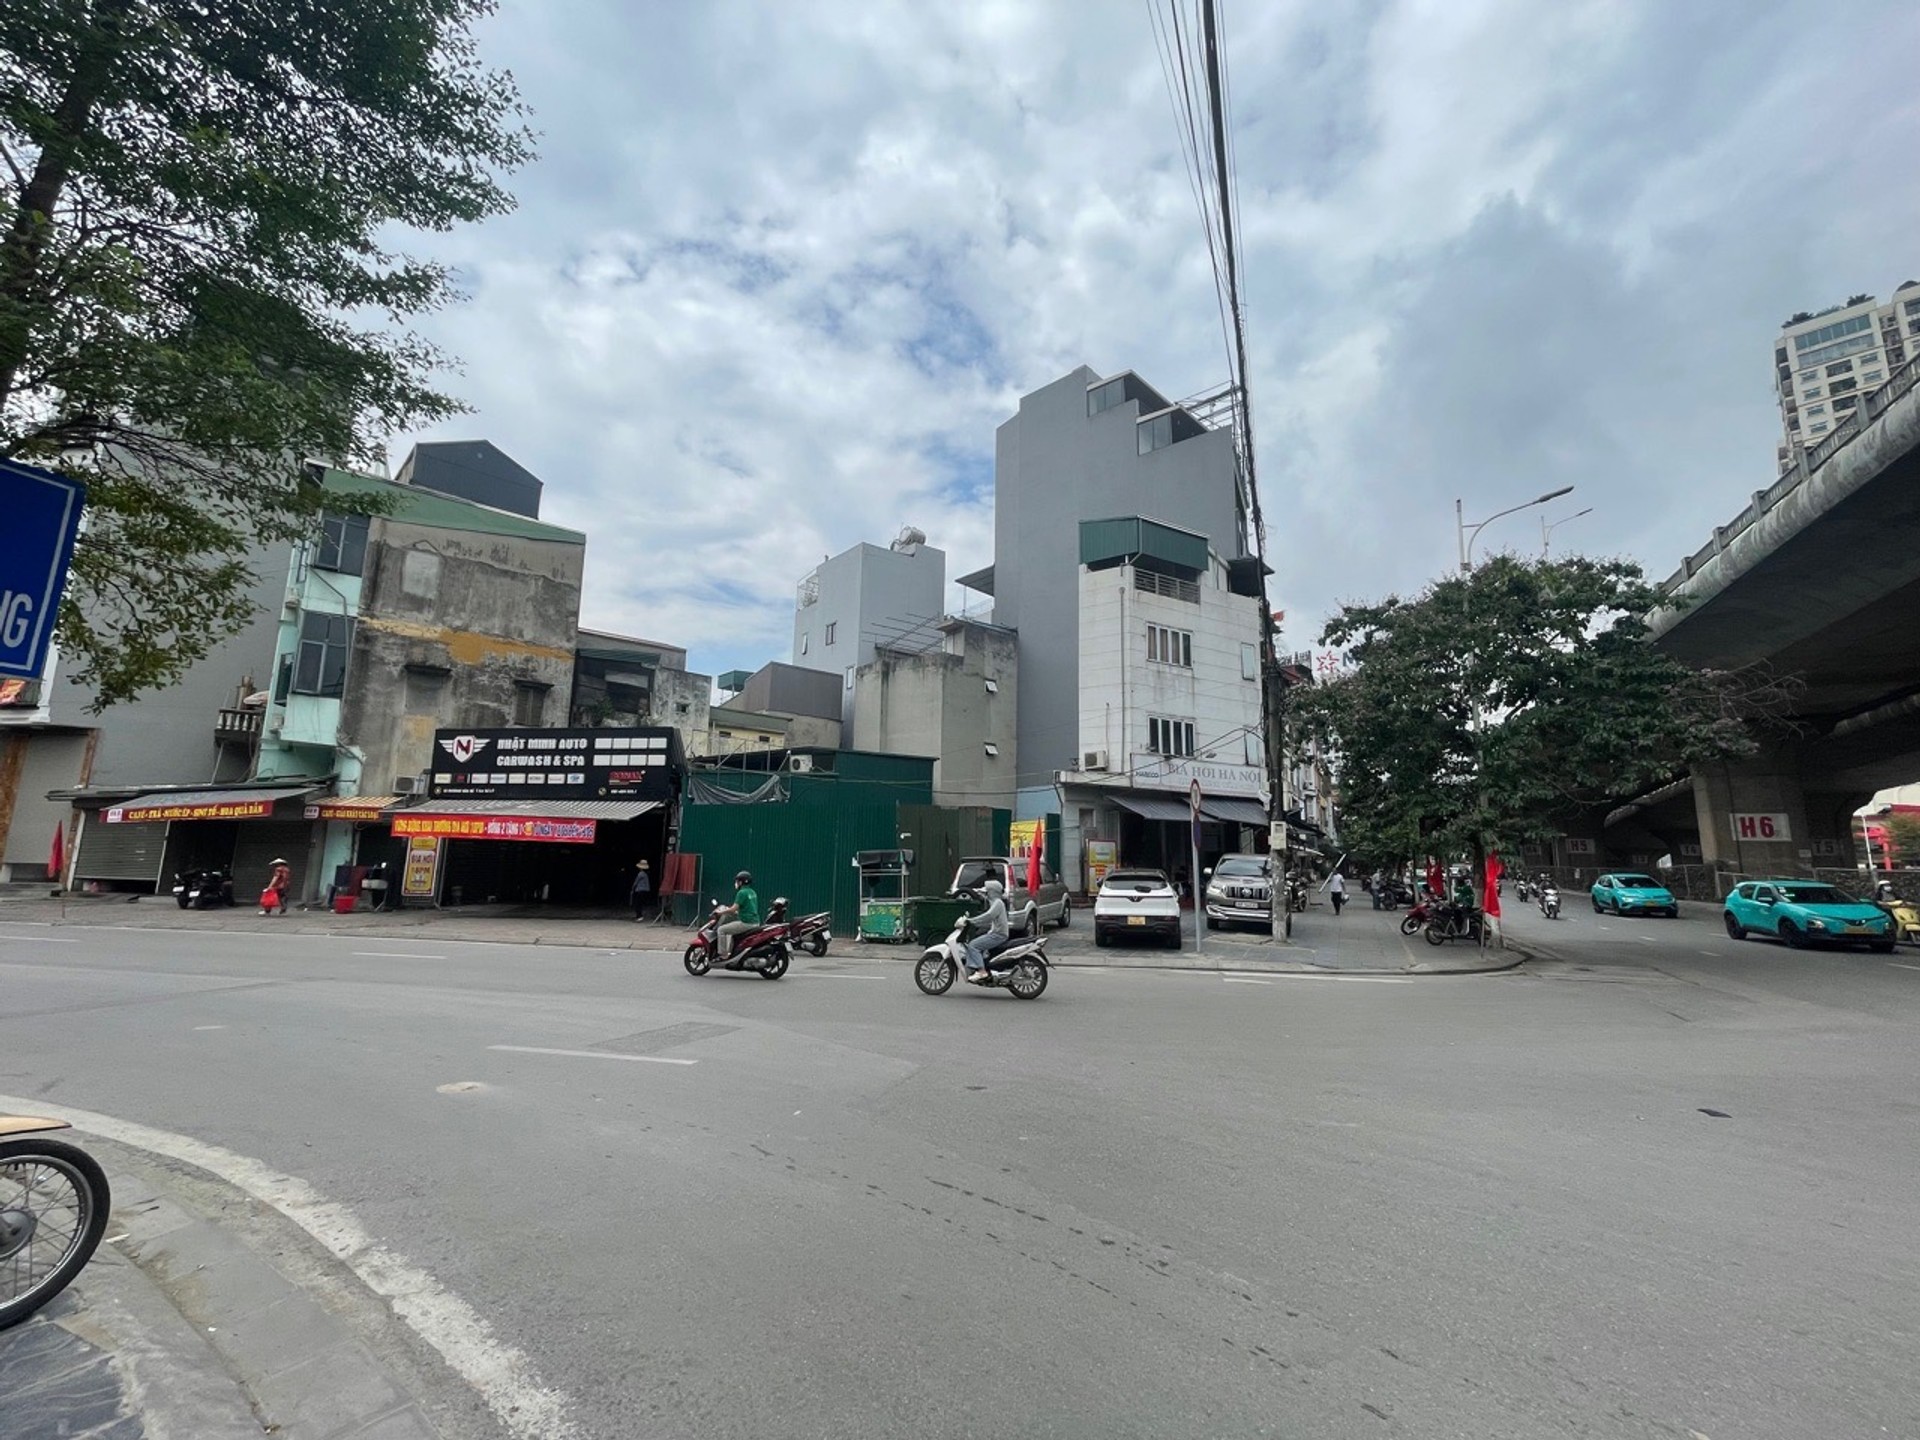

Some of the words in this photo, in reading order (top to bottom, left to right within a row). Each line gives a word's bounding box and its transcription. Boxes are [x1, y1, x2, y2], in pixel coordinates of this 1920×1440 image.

[497, 736, 526, 751] NHẬT
[528, 738, 556, 749] MINH
[558, 738, 588, 749] AUTO
[496, 755, 552, 766] CARWASH
[553, 755, 561, 766] &
[563, 755, 585, 766] SPA
[1168, 764, 1188, 776] BIA
[1740, 816, 1775, 838] H6
[1570, 839, 1588, 851] H5
